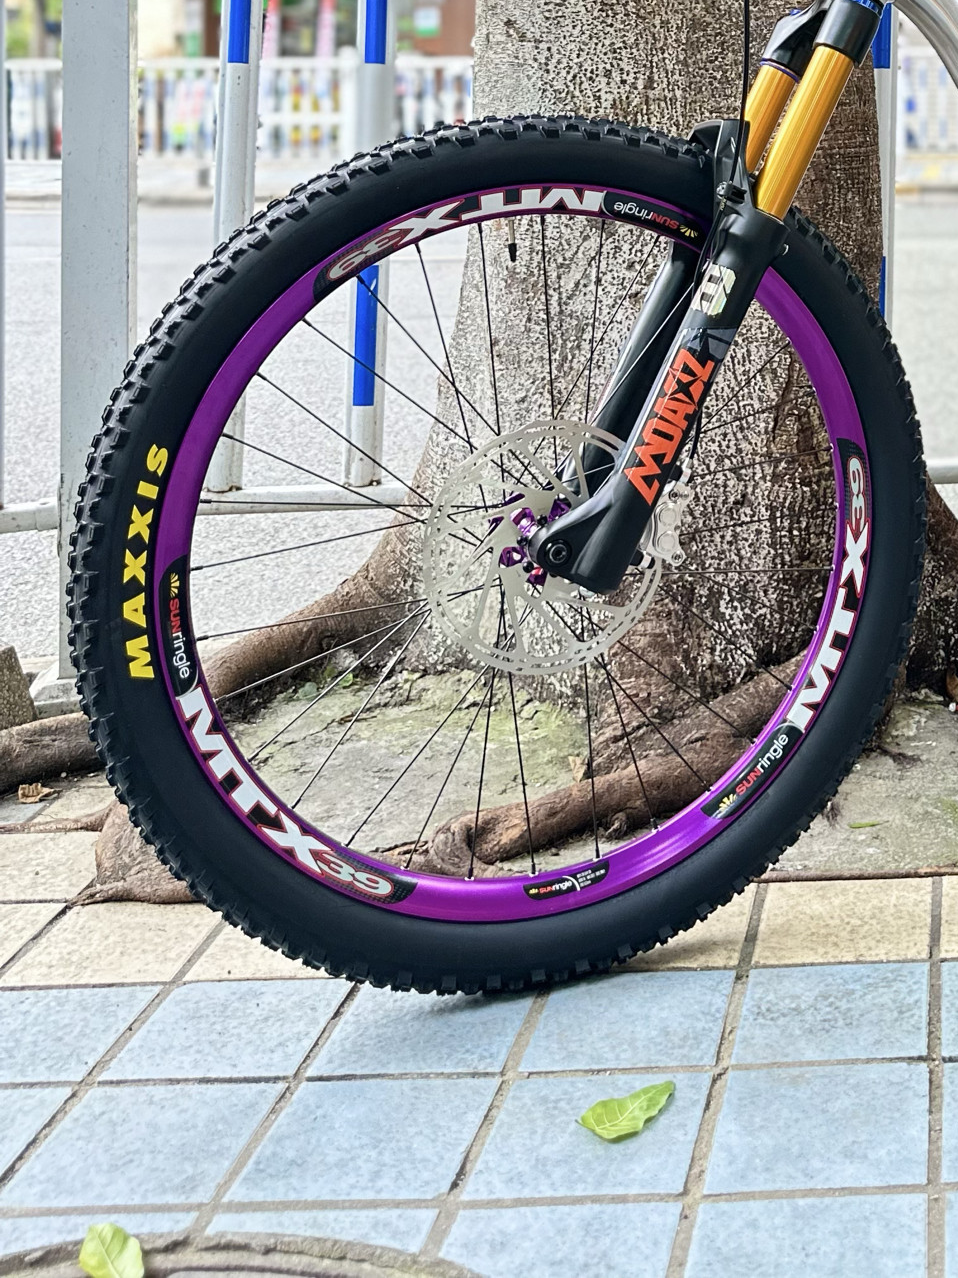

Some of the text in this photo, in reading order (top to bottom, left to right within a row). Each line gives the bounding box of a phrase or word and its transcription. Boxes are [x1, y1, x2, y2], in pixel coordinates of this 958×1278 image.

[327, 187, 603, 281] MTX39
[612, 200, 681, 230] SUNringle
[122, 442, 169, 680] MAXXIS
[786, 455, 870, 734] MTX39
[169, 597, 191, 680] SUNringle
[174, 683, 395, 898] MTX39
[734, 732, 790, 797] SUNringle
